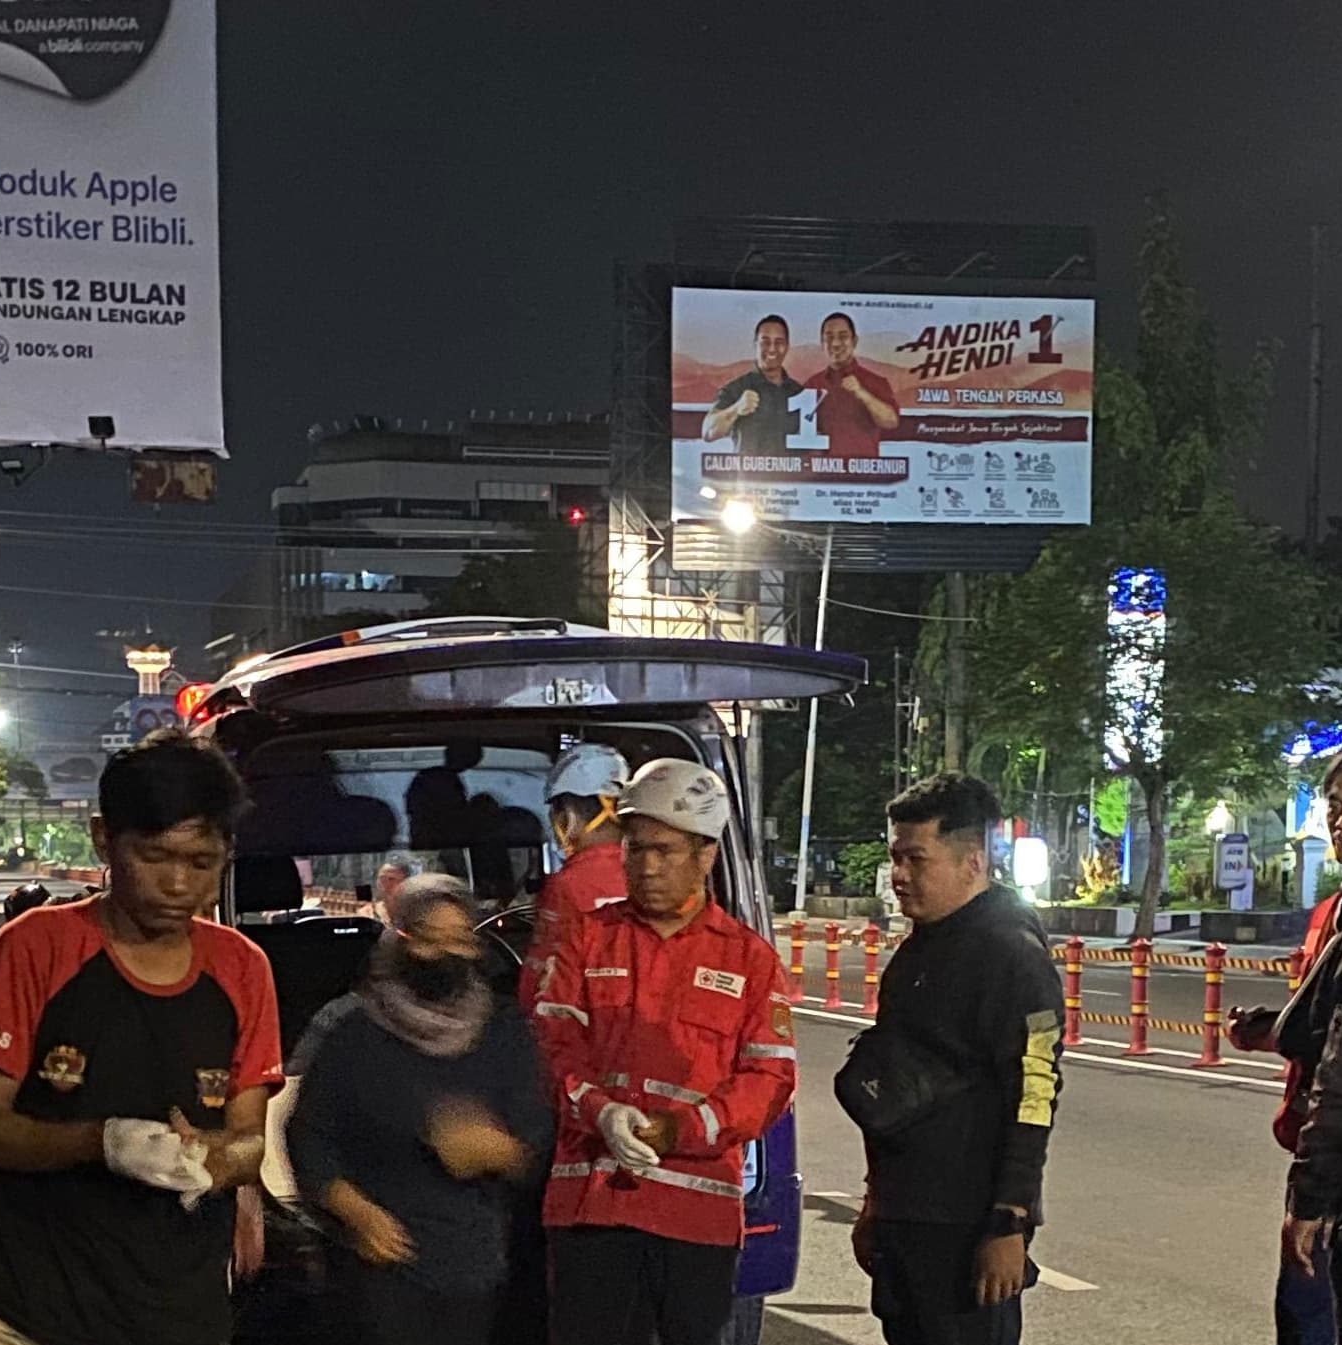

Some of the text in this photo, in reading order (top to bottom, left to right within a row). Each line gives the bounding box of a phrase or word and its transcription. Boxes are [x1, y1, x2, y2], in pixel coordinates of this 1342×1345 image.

[14, 18, 88, 33] DANAPATI
[90, 17, 139, 32] NIAGA
[85, 171, 178, 207] Apple
[111, 215, 195, 246] Blibli.
[51, 279, 81, 302] 12
[89, 281, 186, 306] BULAN
[97, 307, 186, 326] LENGKAP
[15, 342, 93, 359] 100% ORI
[897, 314, 1063, 364] ANDIKA 1
[909, 343, 1015, 380] HENDI
[916, 388, 1064, 406] JAWA TENGAH PERKASA
[786, 388, 830, 450] 1
[704, 456, 741, 471] CALON
[742, 456, 802, 473] GUBERNUR
[811, 457, 847, 473] WAKIL
[848, 458, 906, 475] GUBERNUR
